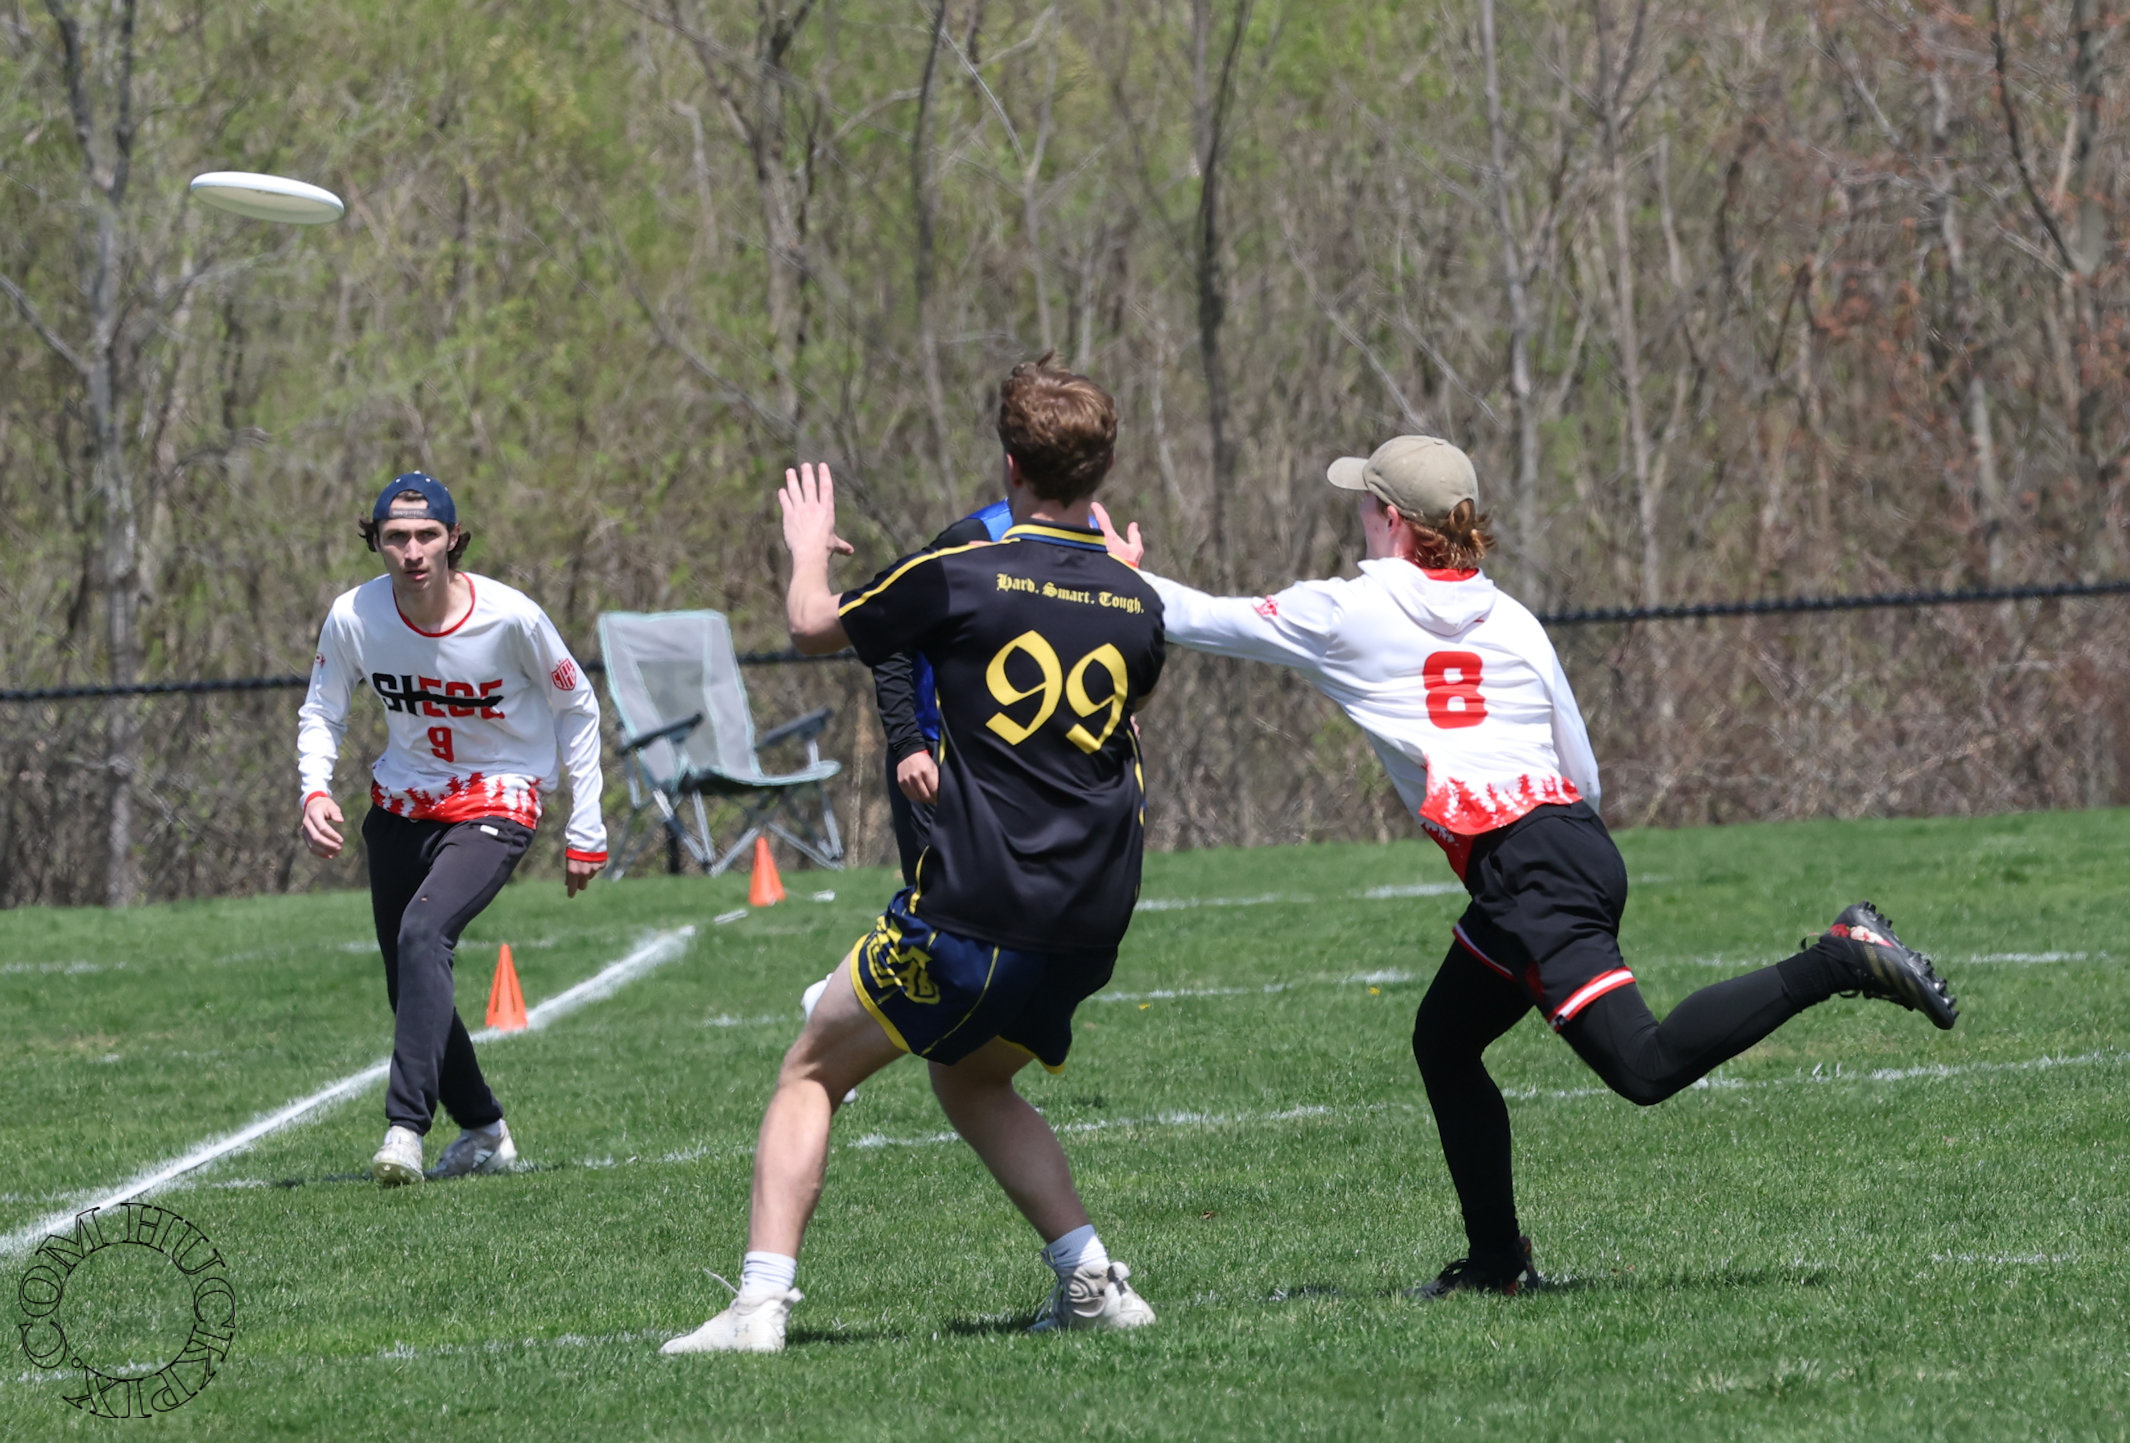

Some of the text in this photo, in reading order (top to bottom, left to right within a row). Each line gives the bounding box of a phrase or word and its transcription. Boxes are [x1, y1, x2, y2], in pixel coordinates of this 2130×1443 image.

[996, 573, 1144, 615] Hard. Smart. Tough.
[985, 629, 1128, 755] 99
[1422, 650, 1489, 729] 8
[427, 726, 455, 763] 9
